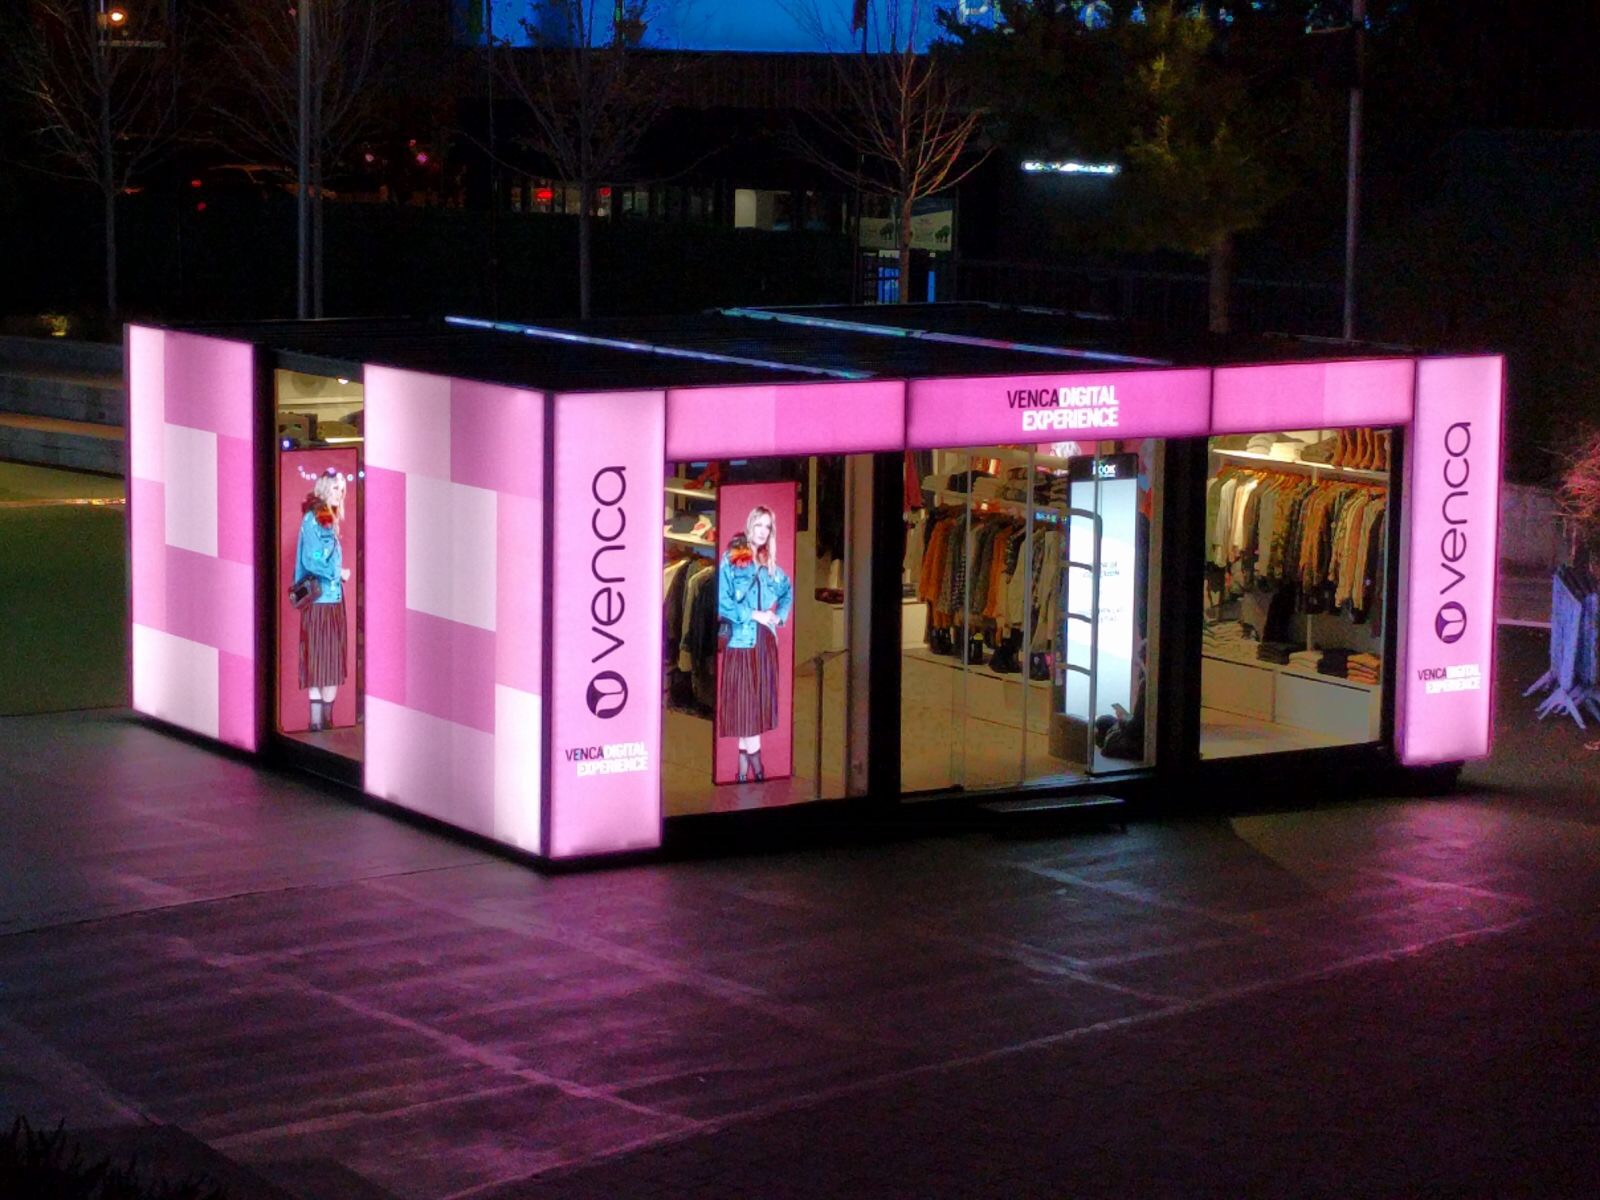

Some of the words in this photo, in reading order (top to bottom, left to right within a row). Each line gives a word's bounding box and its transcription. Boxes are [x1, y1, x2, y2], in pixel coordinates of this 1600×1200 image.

[1022, 407, 1120, 432] EXPERIENCE
[592, 465, 627, 664] venca
[1440, 421, 1472, 595] venca
